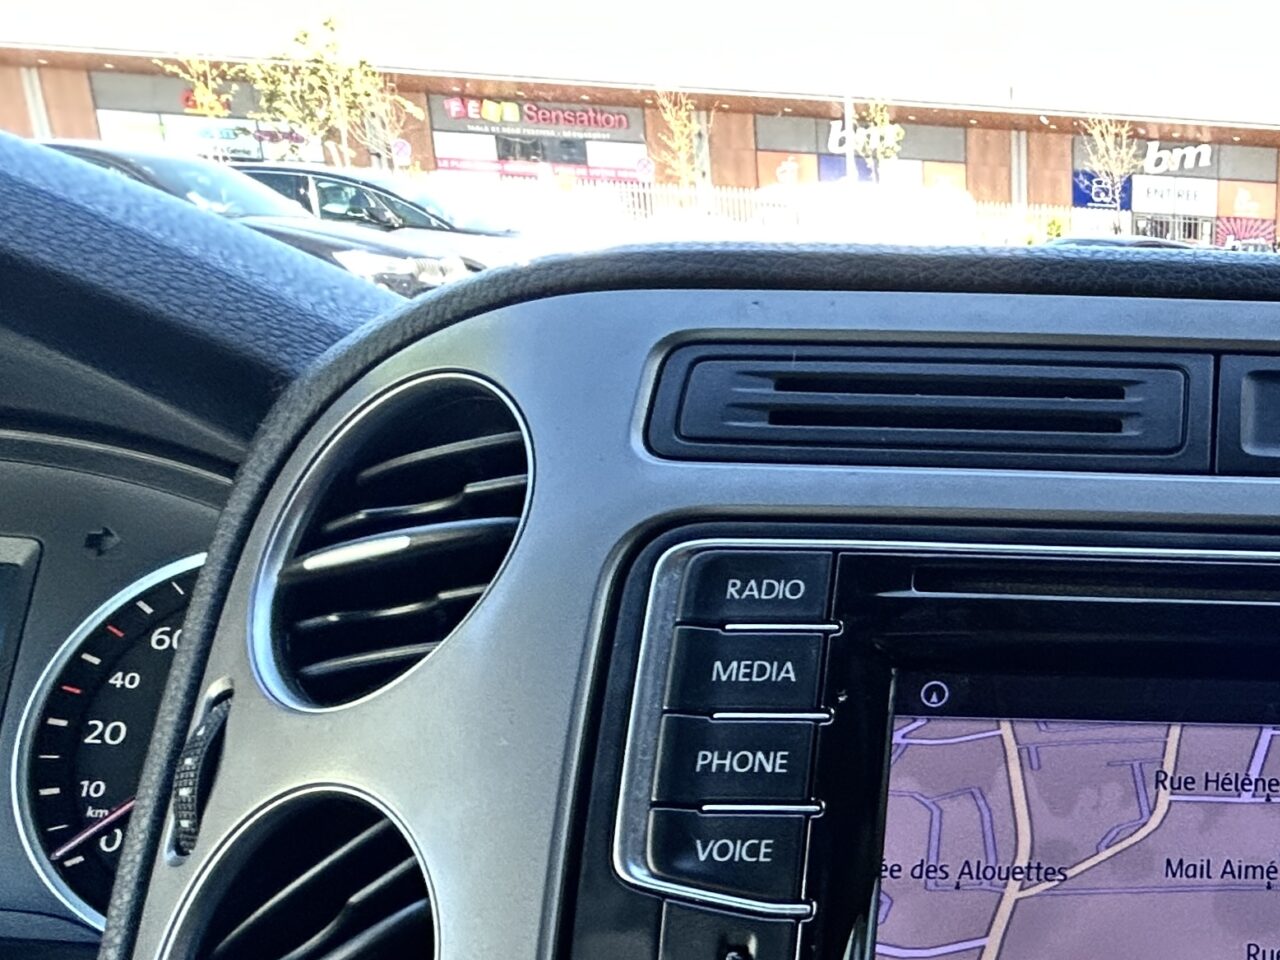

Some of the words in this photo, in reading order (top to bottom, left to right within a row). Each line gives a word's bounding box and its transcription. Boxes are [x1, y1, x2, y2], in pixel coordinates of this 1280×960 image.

[523, 103, 629, 130] Sensation
[1144, 141, 1212, 174] bm
[726, 579, 805, 599] RADIO
[108, 672, 140, 689] 40
[712, 661, 797, 682] MEDIA
[83, 720, 127, 745] 20
[695, 750, 789, 773] PHONE
[80, 780, 106, 798] 10
[1155, 770, 1195, 792] Rue
[1204, 770, 1280, 793] Hélène
[86, 806, 109, 818] km
[695, 839, 773, 862] VOICE
[910, 859, 950, 880] des
[958, 860, 1068, 882] Alouettes
[1165, 858, 1212, 880] Mail
[1220, 858, 1279, 881] Aimé
